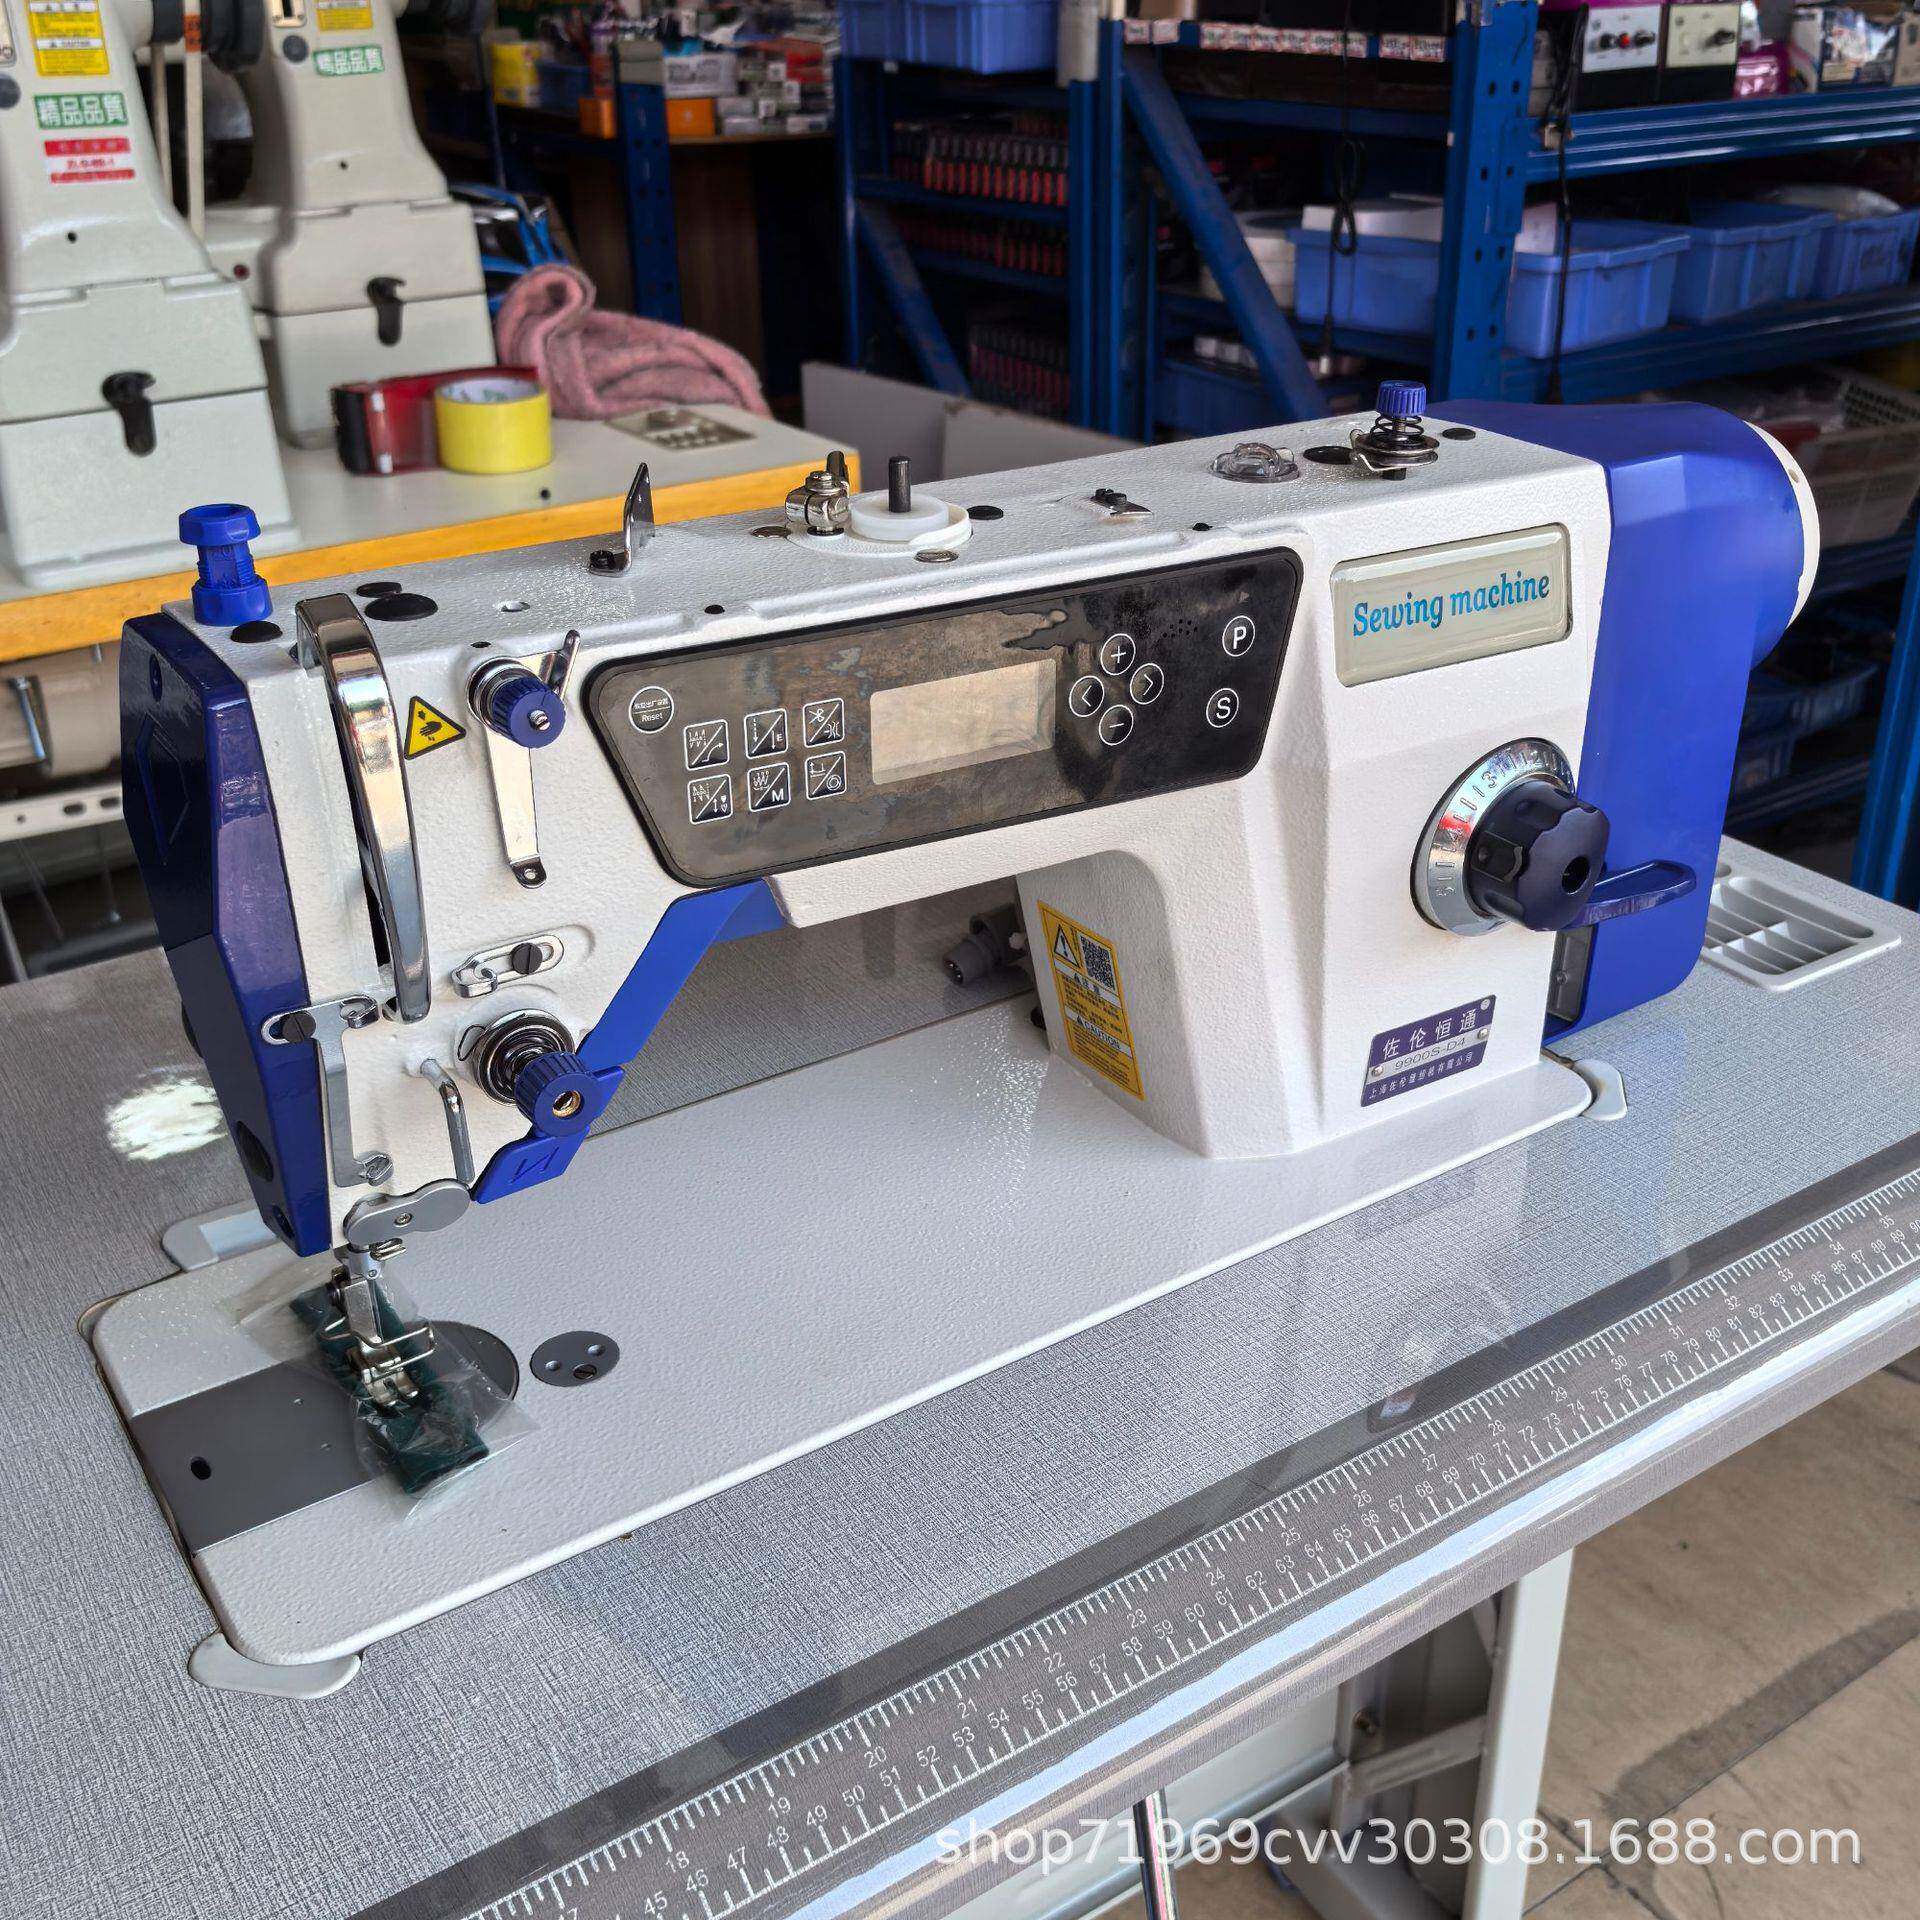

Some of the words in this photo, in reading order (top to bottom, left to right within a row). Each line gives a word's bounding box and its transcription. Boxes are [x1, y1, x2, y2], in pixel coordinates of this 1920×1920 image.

[1353, 592, 1443, 637] Sewing
[1450, 570, 1550, 616] machine
[1233, 626, 1247, 649] P
[641, 712, 663, 722] Reset
[1216, 697, 1231, 719] S
[771, 788, 784, 802] M
[1383, 1008, 1477, 1060] 佐伦恒通
[1395, 1038, 1466, 1070] 9900S-D4
[666, 1851, 690, 1872] 18
[768, 1797, 790, 1818] 19
[864, 1746, 887, 1768] 20
[957, 1698, 977, 1718] 21
[1044, 1652, 1066, 1673] 22
[1126, 1609, 1147, 1628] 23
[1205, 1567, 1226, 1586] 24
[1281, 1527, 1300, 1546] 25
[1353, 1489, 1372, 1508] 26
[1422, 1453, 1438, 1471] 27
[1488, 1419, 1505, 1436] 28
[1551, 1386, 1568, 1403] 29
[1611, 1354, 1628, 1371] 30
[1668, 1325, 1685, 1340] 31
[1724, 1295, 1741, 1310] 32
[1778, 1268, 1793, 1282] 33
[1829, 1241, 1844, 1255] 34
[1880, 1215, 1894, 1229] 35
[644, 1891, 667, 1915] 45
[686, 1869, 709, 1892] 46
[727, 1846, 746, 1870] 47
[767, 1826, 790, 1848] 48
[806, 1805, 828, 1826] 49
[842, 1784, 865, 1807] 50
[880, 1766, 901, 1787] 51
[917, 1745, 940, 1767] 52
[952, 1726, 975, 1747] 53
[987, 1707, 1010, 1729] 54
[1022, 1689, 1044, 1710] 55
[1056, 1671, 1077, 1692] 56
[1089, 1653, 1108, 1674] 57
[1122, 1636, 1143, 1656] 58
[1153, 1619, 1174, 1639] 59
[1184, 1603, 1206, 1622] 60
[1215, 1587, 1234, 1606] 61
[1245, 1571, 1266, 1590] 62
[1275, 1554, 1295, 1574] 63
[1304, 1539, 1324, 1558] 64
[1333, 1524, 1352, 1542] 65
[1361, 1509, 1379, 1527] 66
[1388, 1494, 1405, 1512] 67
[1415, 1480, 1433, 1498] 68
[1442, 1466, 1459, 1484] 69
[1467, 1452, 1485, 1470] 70
[1492, 1439, 1510, 1456] 71
[1517, 1425, 1537, 1442] 72
[1542, 1412, 1561, 1429] 73
[1567, 1399, 1585, 1416] 74
[1591, 1387, 1609, 1403] 75
[1614, 1374, 1632, 1390] 76
[1637, 1361, 1653, 1378] 77
[1660, 1350, 1678, 1366] 78
[1682, 1337, 1700, 1353] 79
[1706, 1327, 1722, 1342] 80
[1727, 1315, 1742, 1330] 81
[1749, 1304, 1765, 1319] 82
[1769, 1292, 1785, 1307] 83
[1790, 1282, 1806, 1296] 84
[1811, 1271, 1826, 1285] 85
[1831, 1260, 1847, 1275] 86
[1851, 1249, 1864, 1264] 87
[1871, 1239, 1886, 1254] 88
[1890, 1229, 1905, 1243] 89
